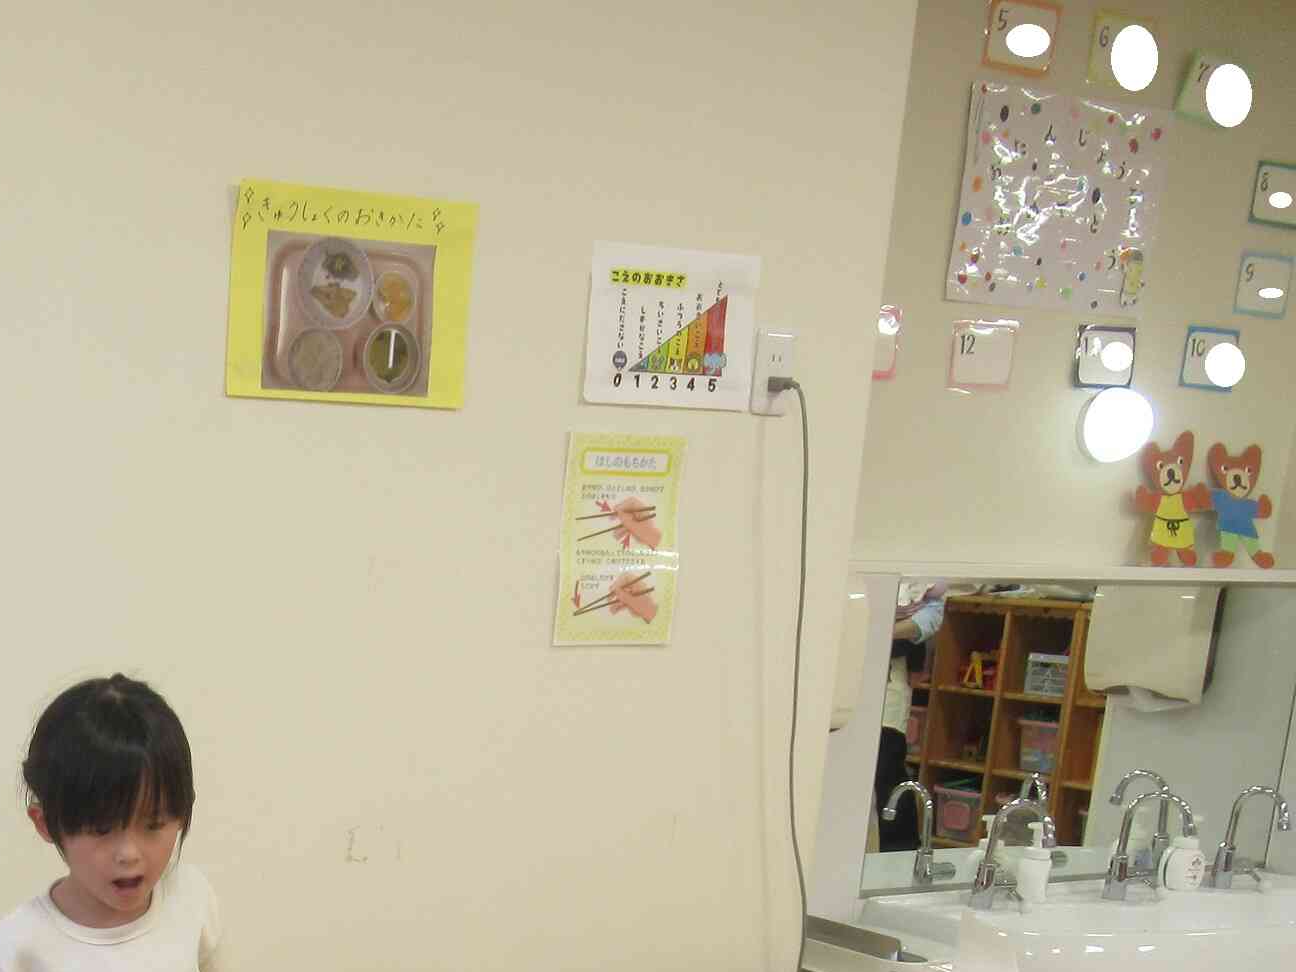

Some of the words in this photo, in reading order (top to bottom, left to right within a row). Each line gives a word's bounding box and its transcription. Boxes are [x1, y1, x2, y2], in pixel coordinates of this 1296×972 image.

[998, 10, 1008, 30] 5
[1098, 25, 1109, 47] 6
[611, 270, 685, 287] こえのおおきさ
[959, 334, 976, 355] 12
[1191, 338, 1206, 357] 10
[613, 373, 622, 387] 0
[634, 375, 641, 388] 1
[651, 375, 660, 389] 2
[669, 376, 678, 390] 3
[687, 377, 695, 391] 4
[707, 378, 717, 392] 5
